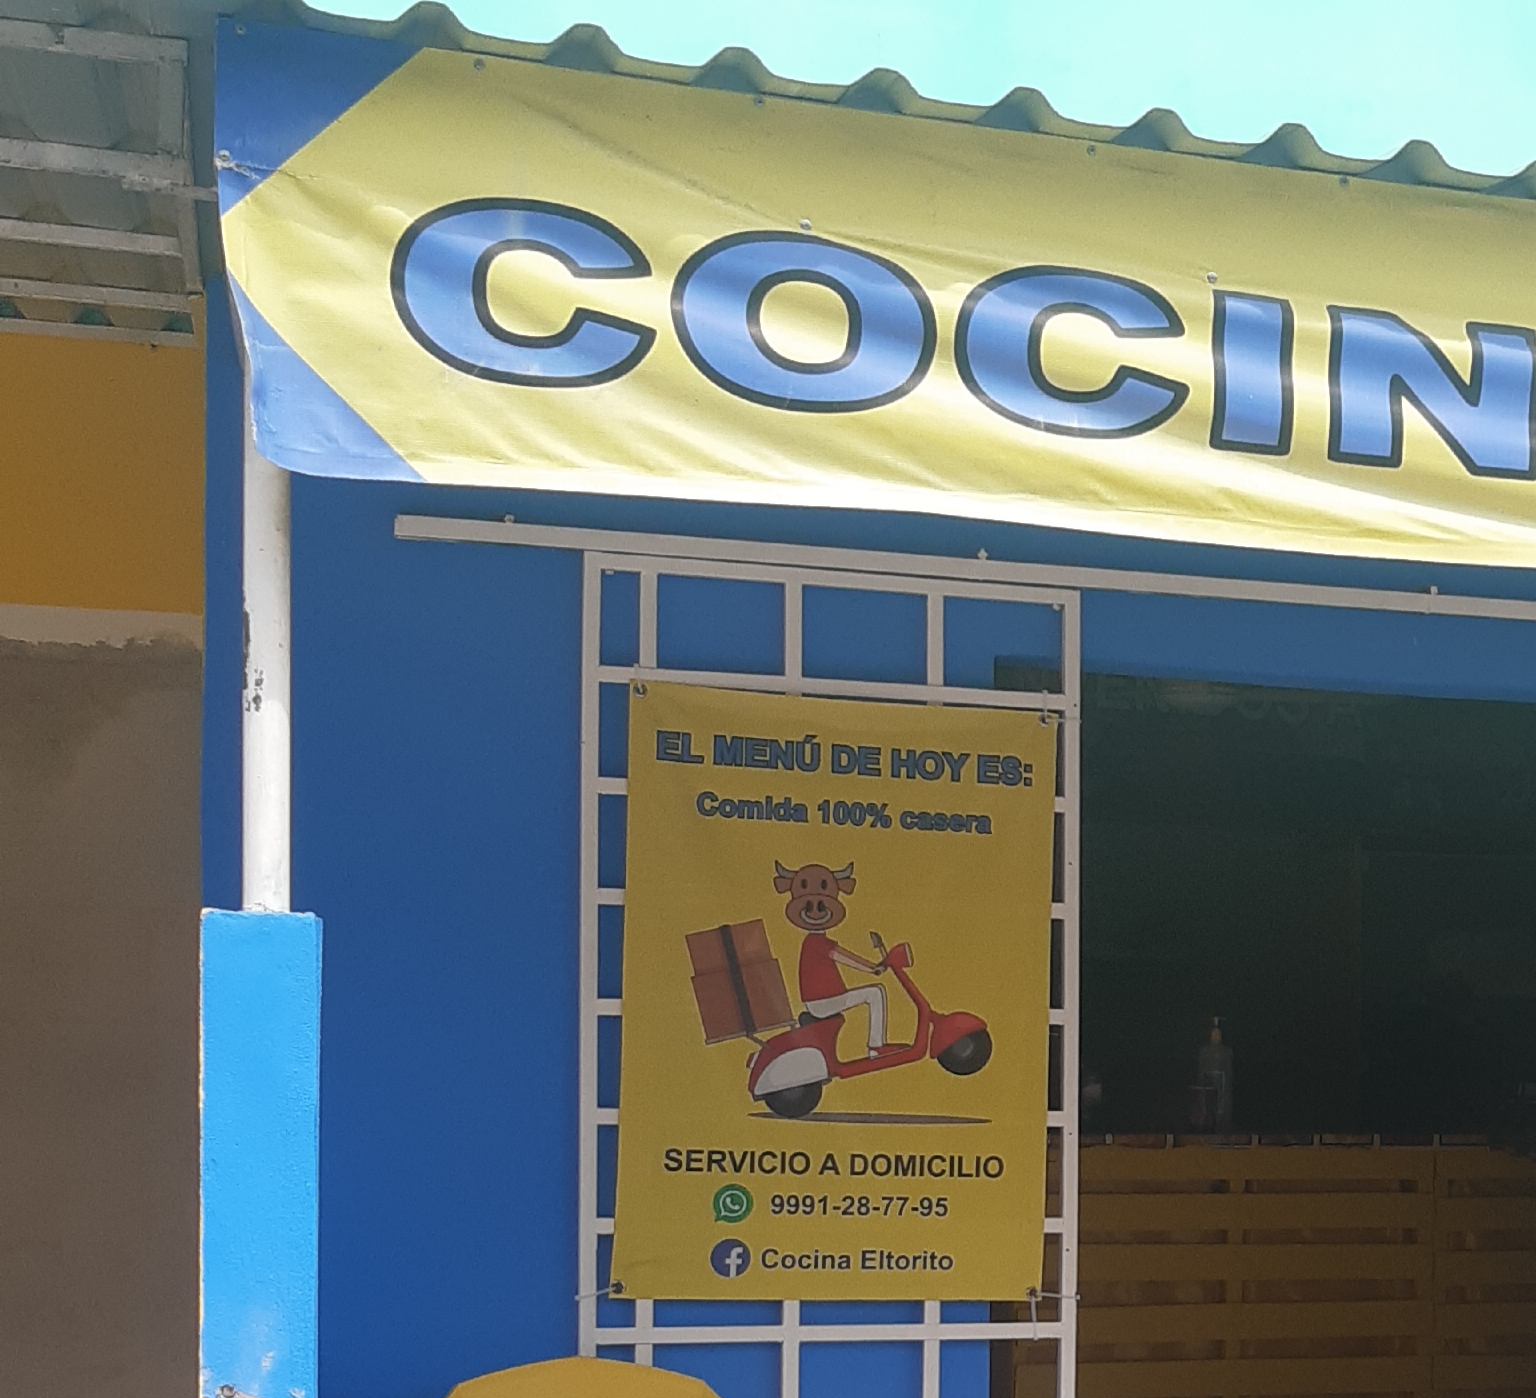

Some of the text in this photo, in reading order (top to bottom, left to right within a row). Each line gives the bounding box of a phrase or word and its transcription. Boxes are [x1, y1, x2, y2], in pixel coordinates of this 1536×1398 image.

[656, 730, 1033, 787] EL MENÚ DE HOY ES:
[696, 791, 992, 835] Comida 100% casera
[663, 1148, 1004, 1179] SERVICIO A DOMICILIO
[770, 1194, 949, 1218] 9991-28-77-95
[760, 1248, 851, 1271] Cocina
[860, 1249, 954, 1272] Eltorito
